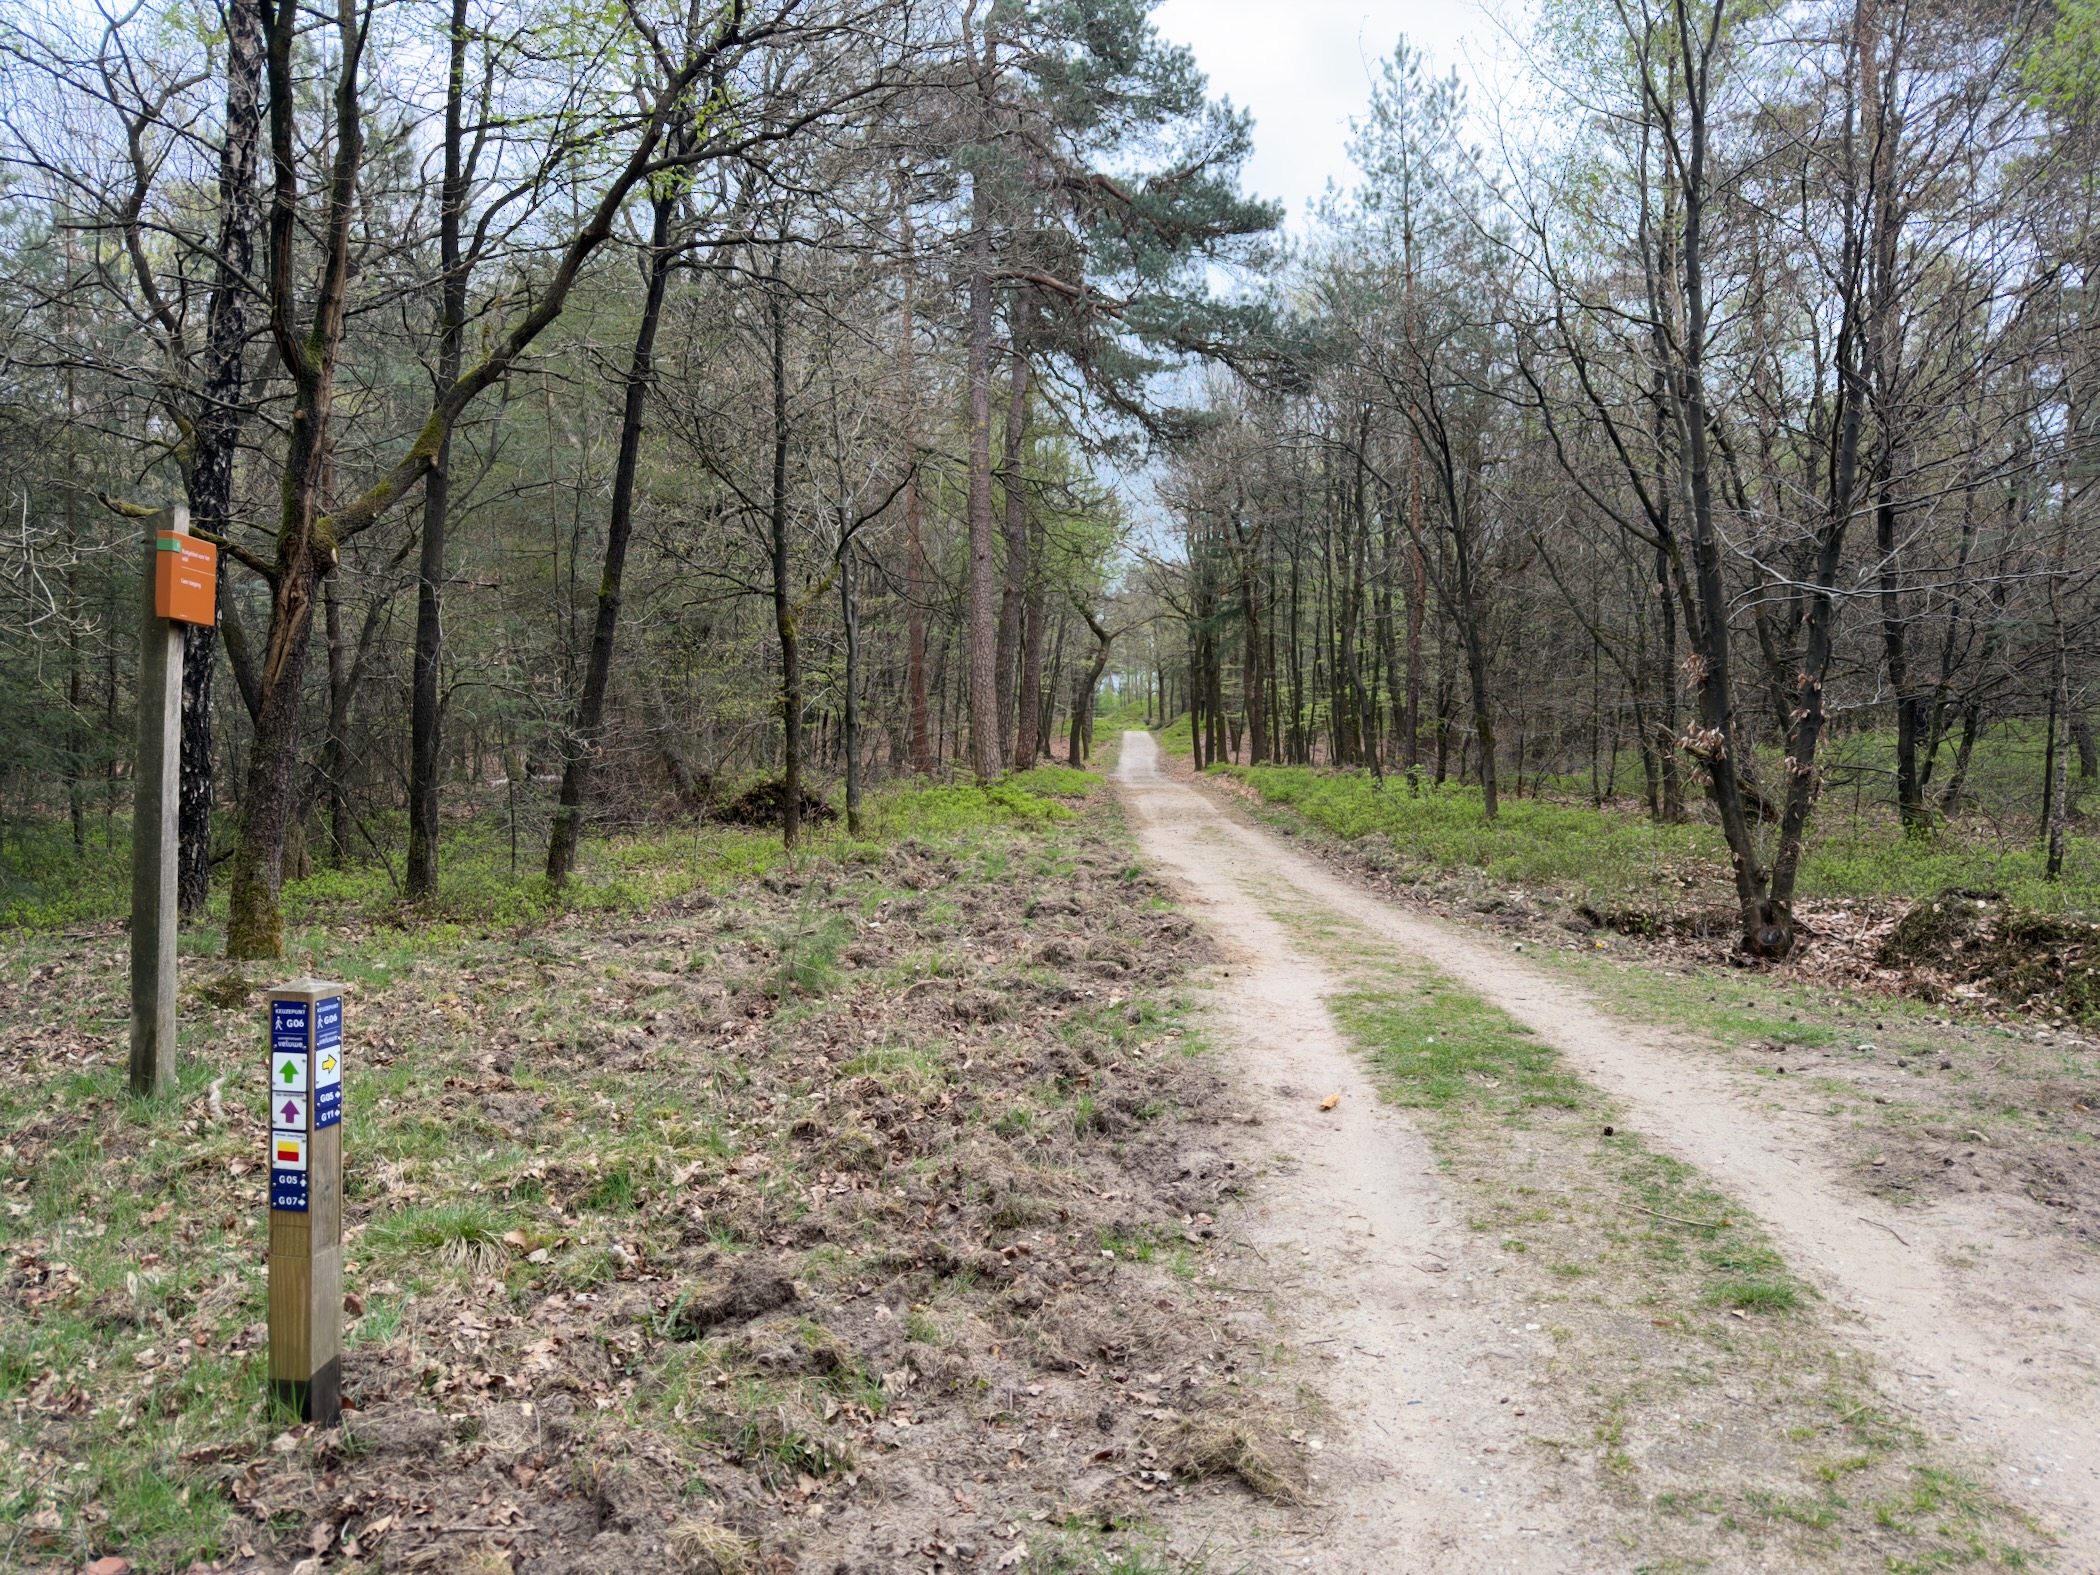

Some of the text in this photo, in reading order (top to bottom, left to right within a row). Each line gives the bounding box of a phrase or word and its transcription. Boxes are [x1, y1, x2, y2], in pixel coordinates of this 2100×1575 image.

[317, 1003, 339, 1013] KEUZEPUNT
[286, 1018, 305, 1028] G06
[323, 1013, 338, 1025] G06
[277, 1039, 304, 1048] veluwe
[320, 1091, 334, 1103] G05
[321, 1109, 334, 1122] G11
[278, 1174, 298, 1185] G05
[278, 1195, 298, 1206] G07
